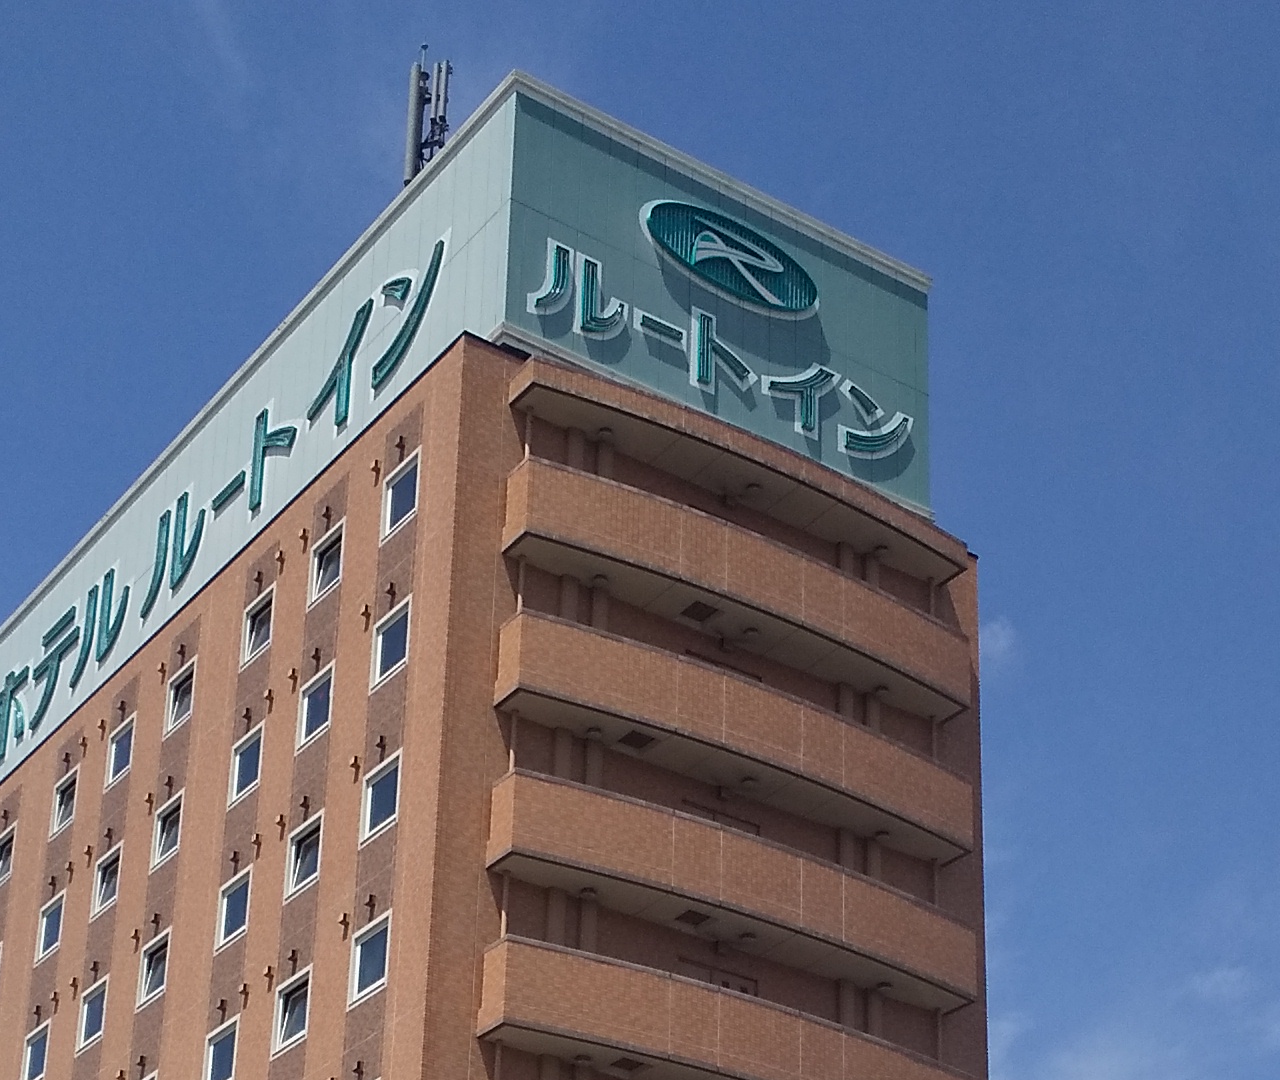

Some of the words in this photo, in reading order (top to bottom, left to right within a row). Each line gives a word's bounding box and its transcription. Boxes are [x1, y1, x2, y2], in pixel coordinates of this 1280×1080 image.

[140, 239, 446, 620] ルートイン
[527, 238, 914, 460] ルートイン
